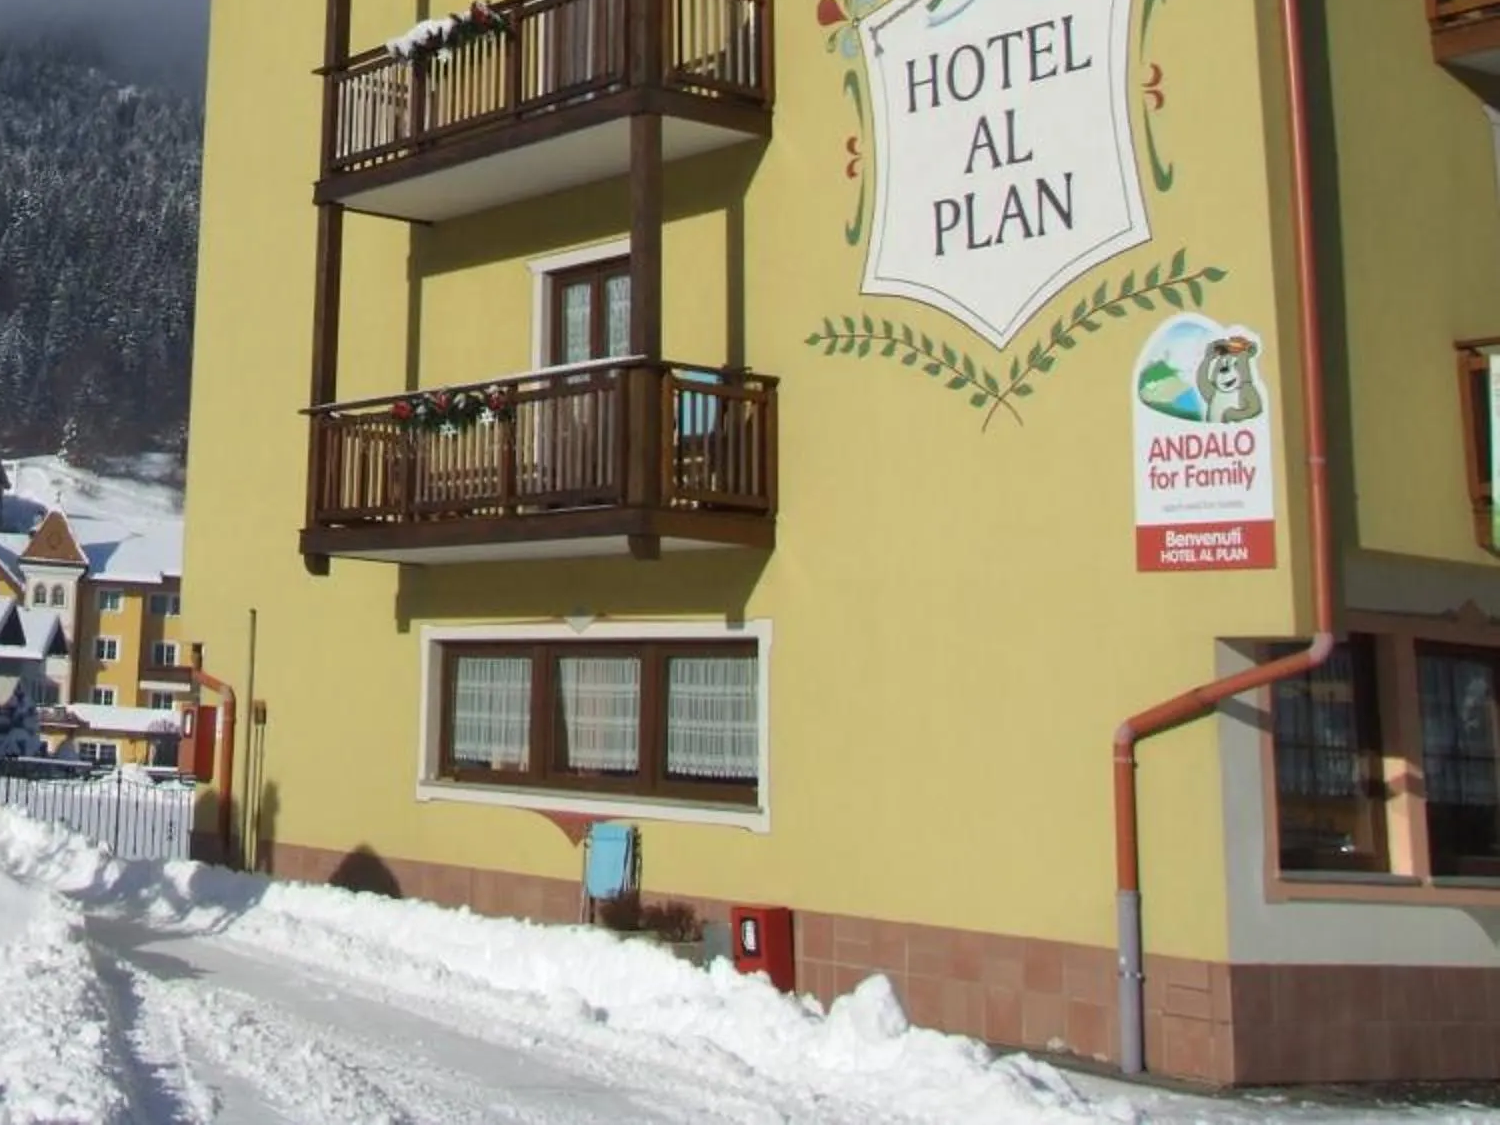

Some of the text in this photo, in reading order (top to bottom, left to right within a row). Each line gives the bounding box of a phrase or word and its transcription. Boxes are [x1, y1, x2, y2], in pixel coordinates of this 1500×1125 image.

[906, 15, 1092, 113] HOTEL
[964, 109, 1033, 174] AL
[933, 172, 1073, 256] PLAN
[1149, 430, 1255, 463] ANDALO
[1149, 461, 1255, 491] for Family
[1165, 528, 1242, 547] Benvenuti
[1160, 547, 1248, 563] HOTEL AL PLAN
